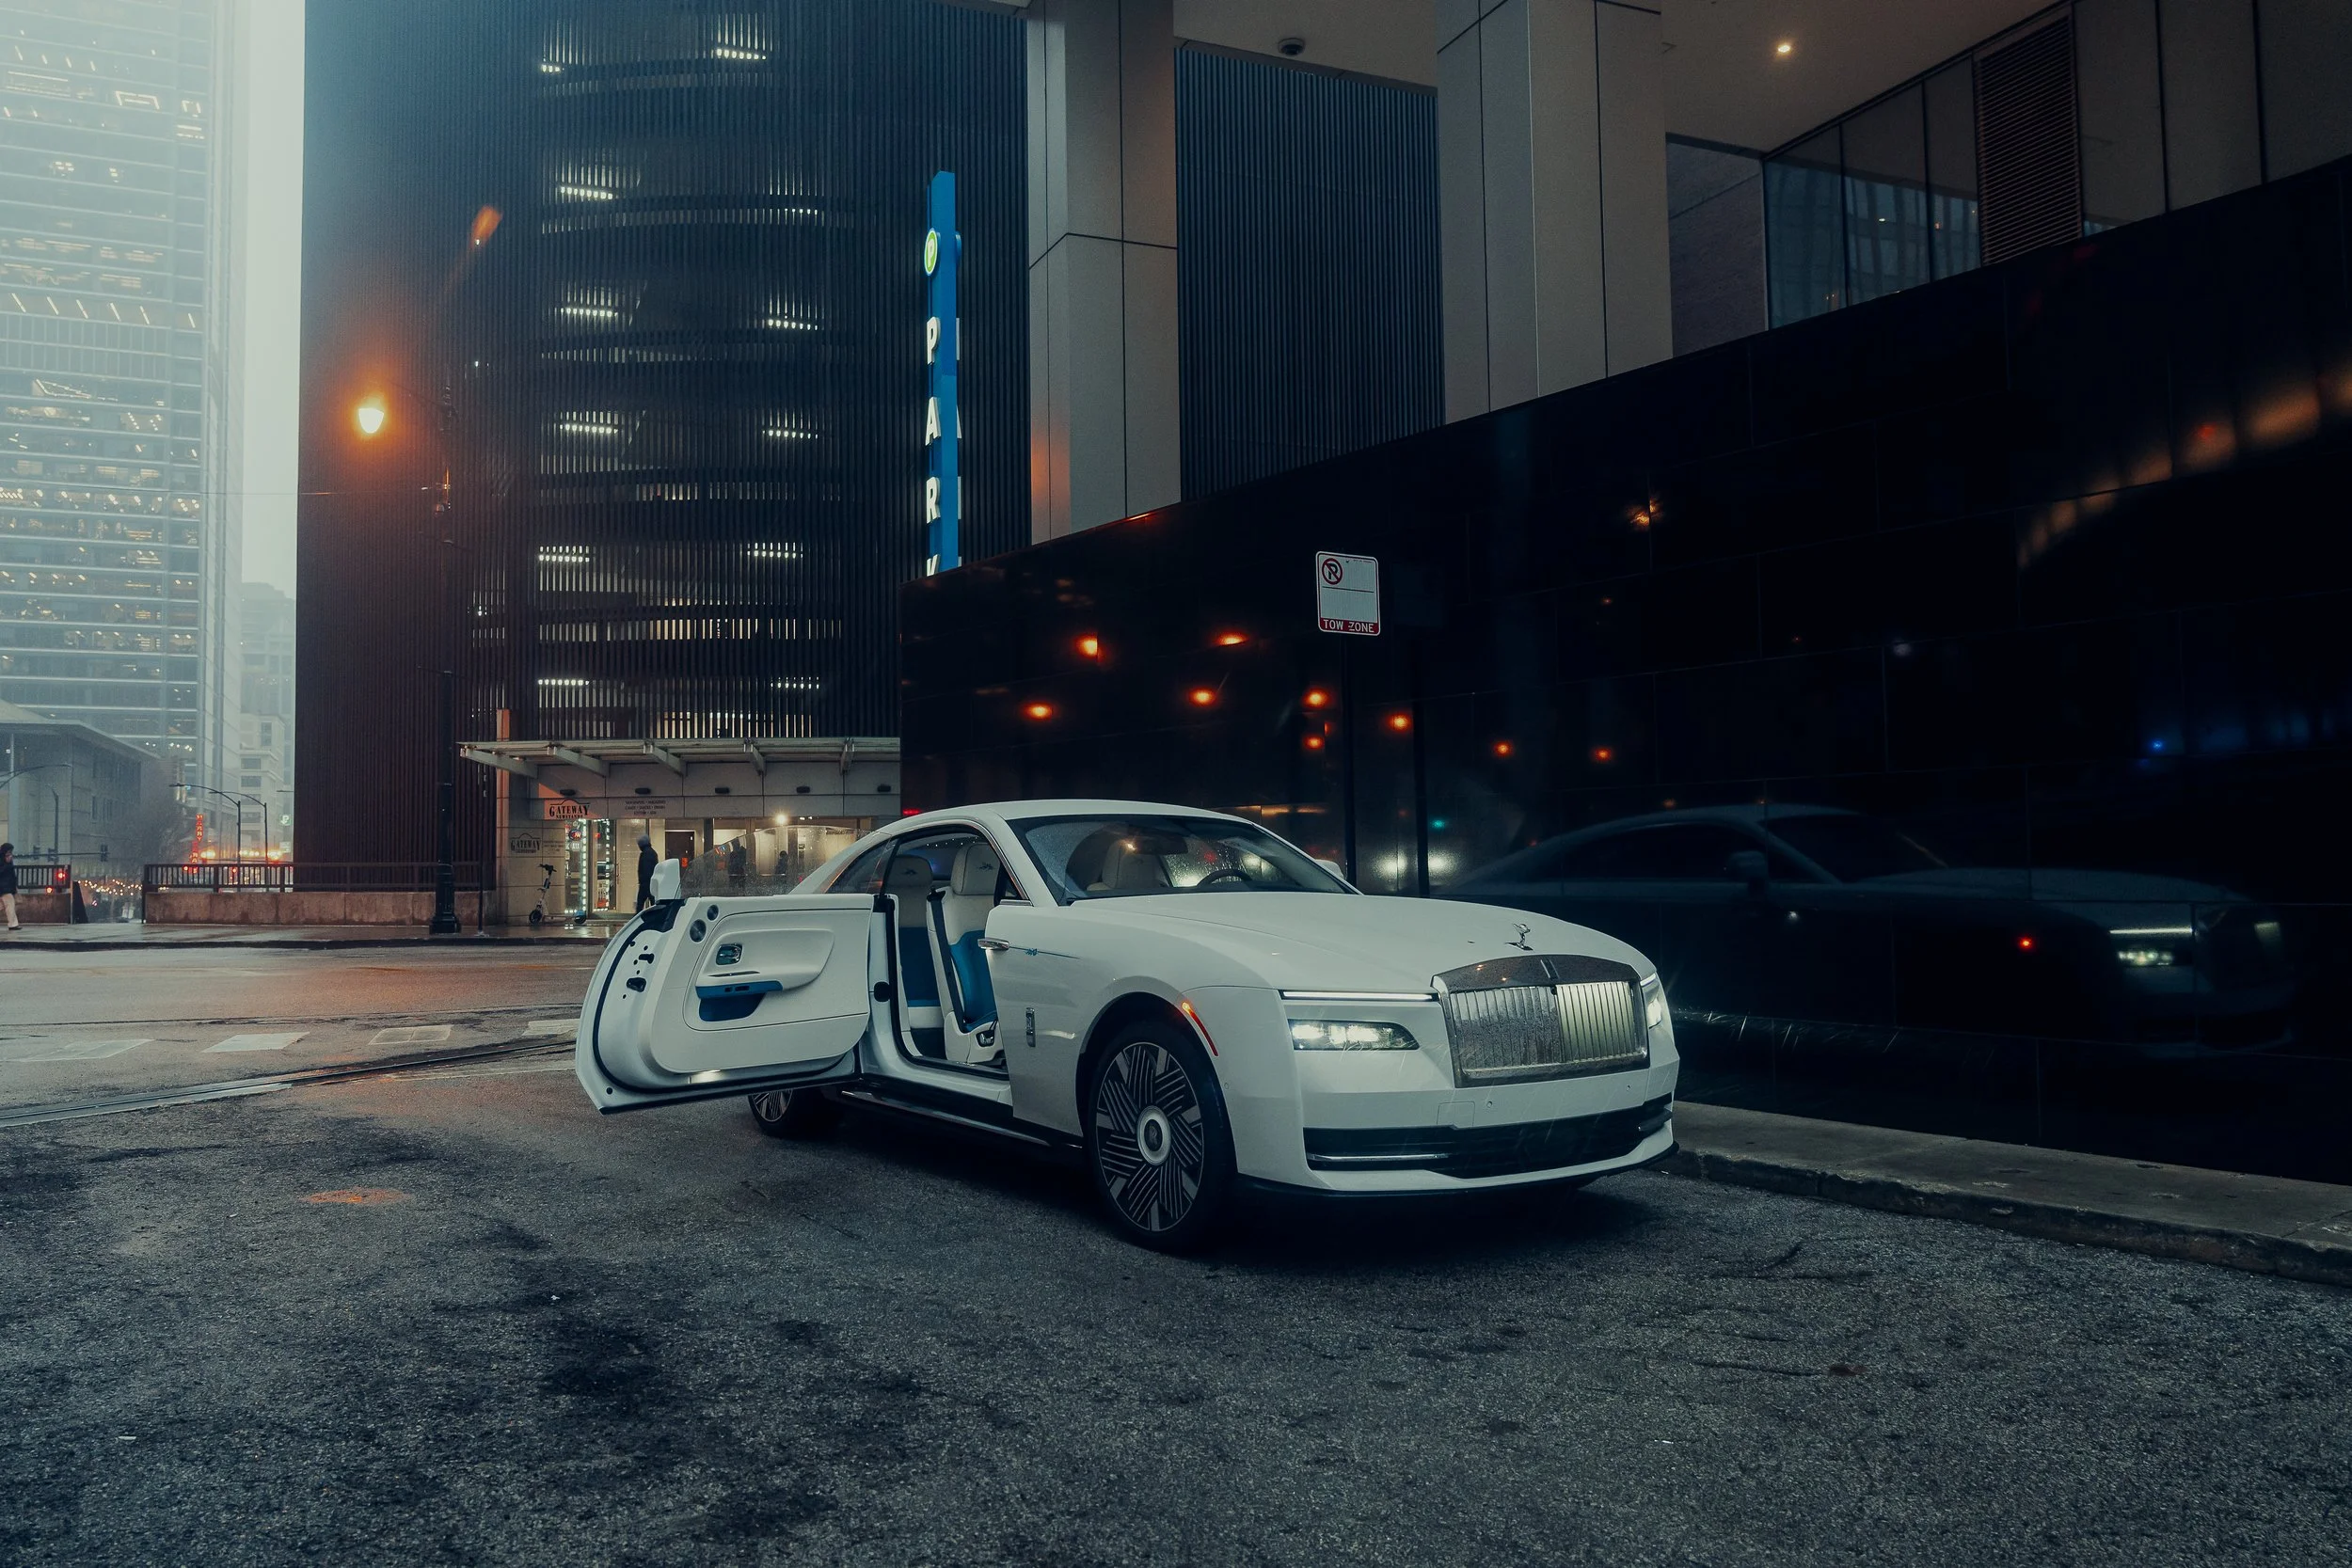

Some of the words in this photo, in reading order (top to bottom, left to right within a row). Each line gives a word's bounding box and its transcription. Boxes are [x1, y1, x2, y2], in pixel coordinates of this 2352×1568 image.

[1323, 619, 1344, 630] TOW
[1348, 621, 1375, 633] ZONE
[548, 804, 591, 817] GATEWAY
